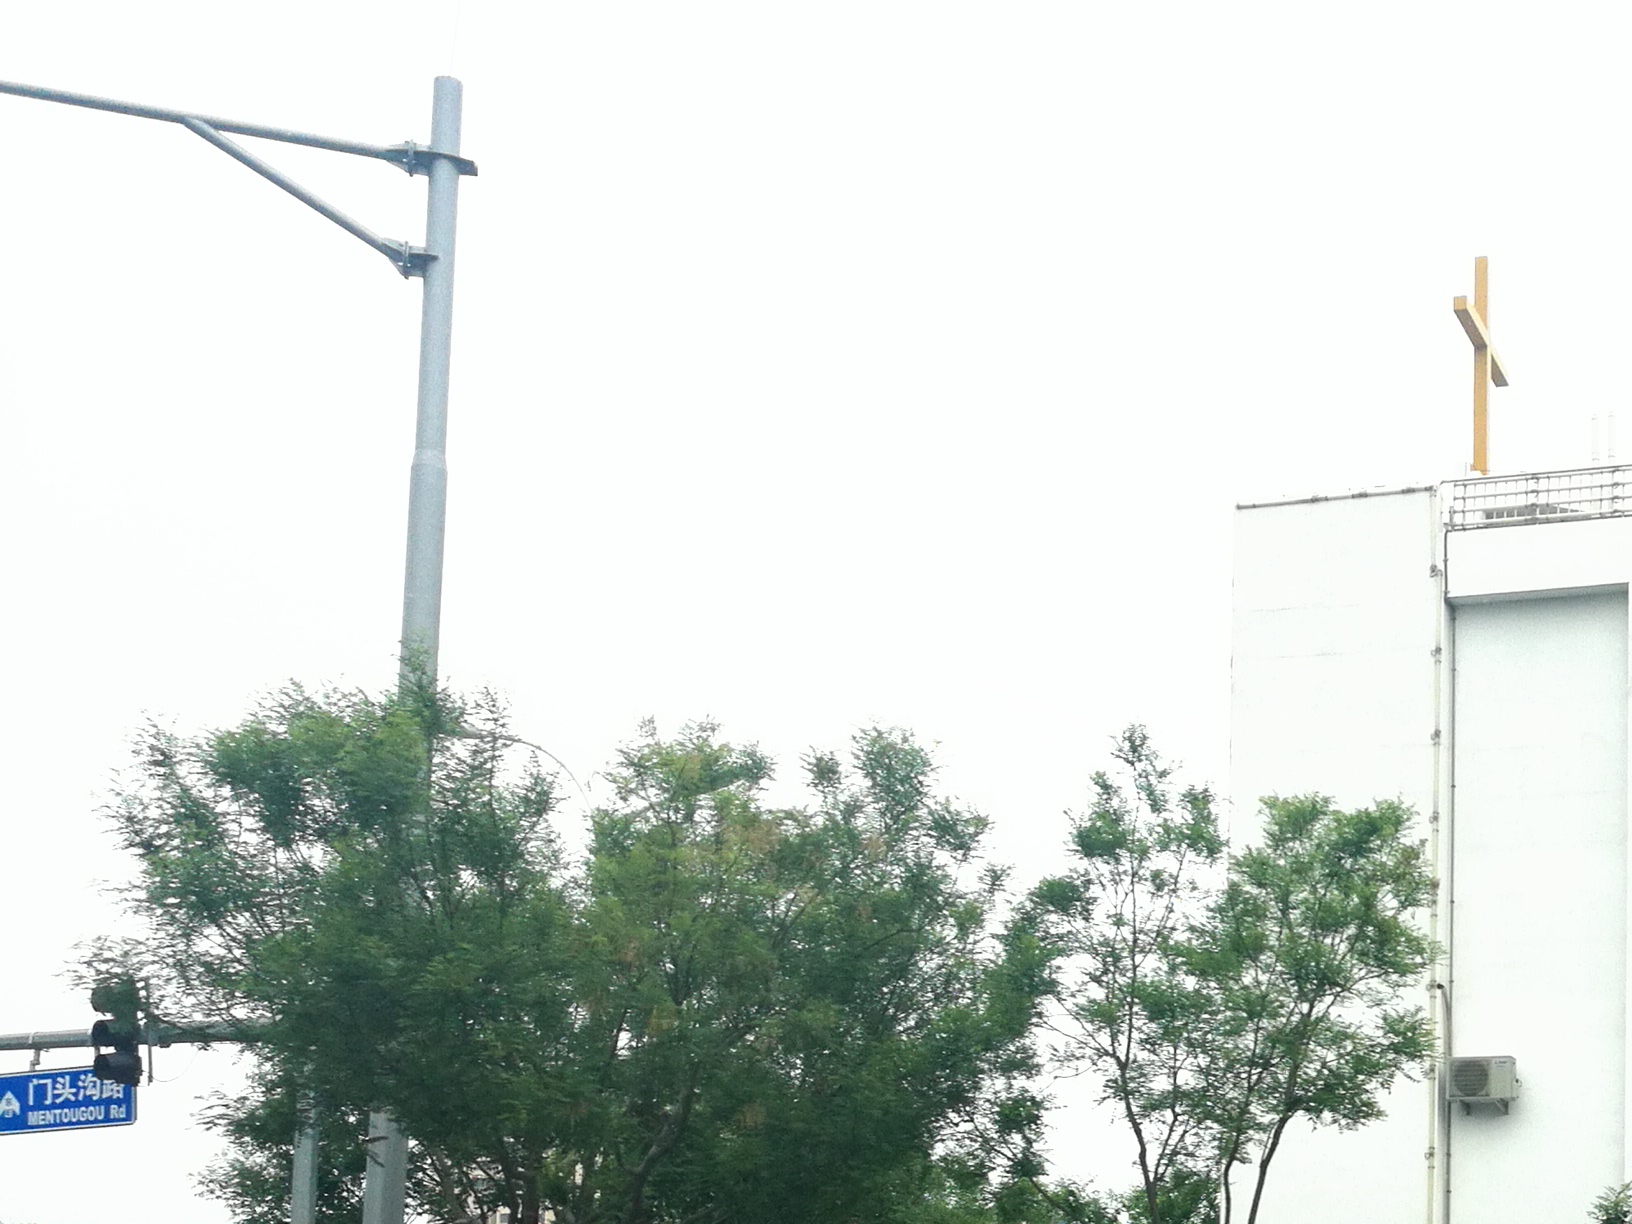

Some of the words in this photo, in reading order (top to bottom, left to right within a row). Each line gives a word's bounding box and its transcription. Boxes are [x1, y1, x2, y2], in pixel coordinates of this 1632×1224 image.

[28, 1073, 125, 1106] 门头沟路
[27, 1105, 105, 1126] MENTOUGOU
[110, 1104, 126, 1119] Rd
